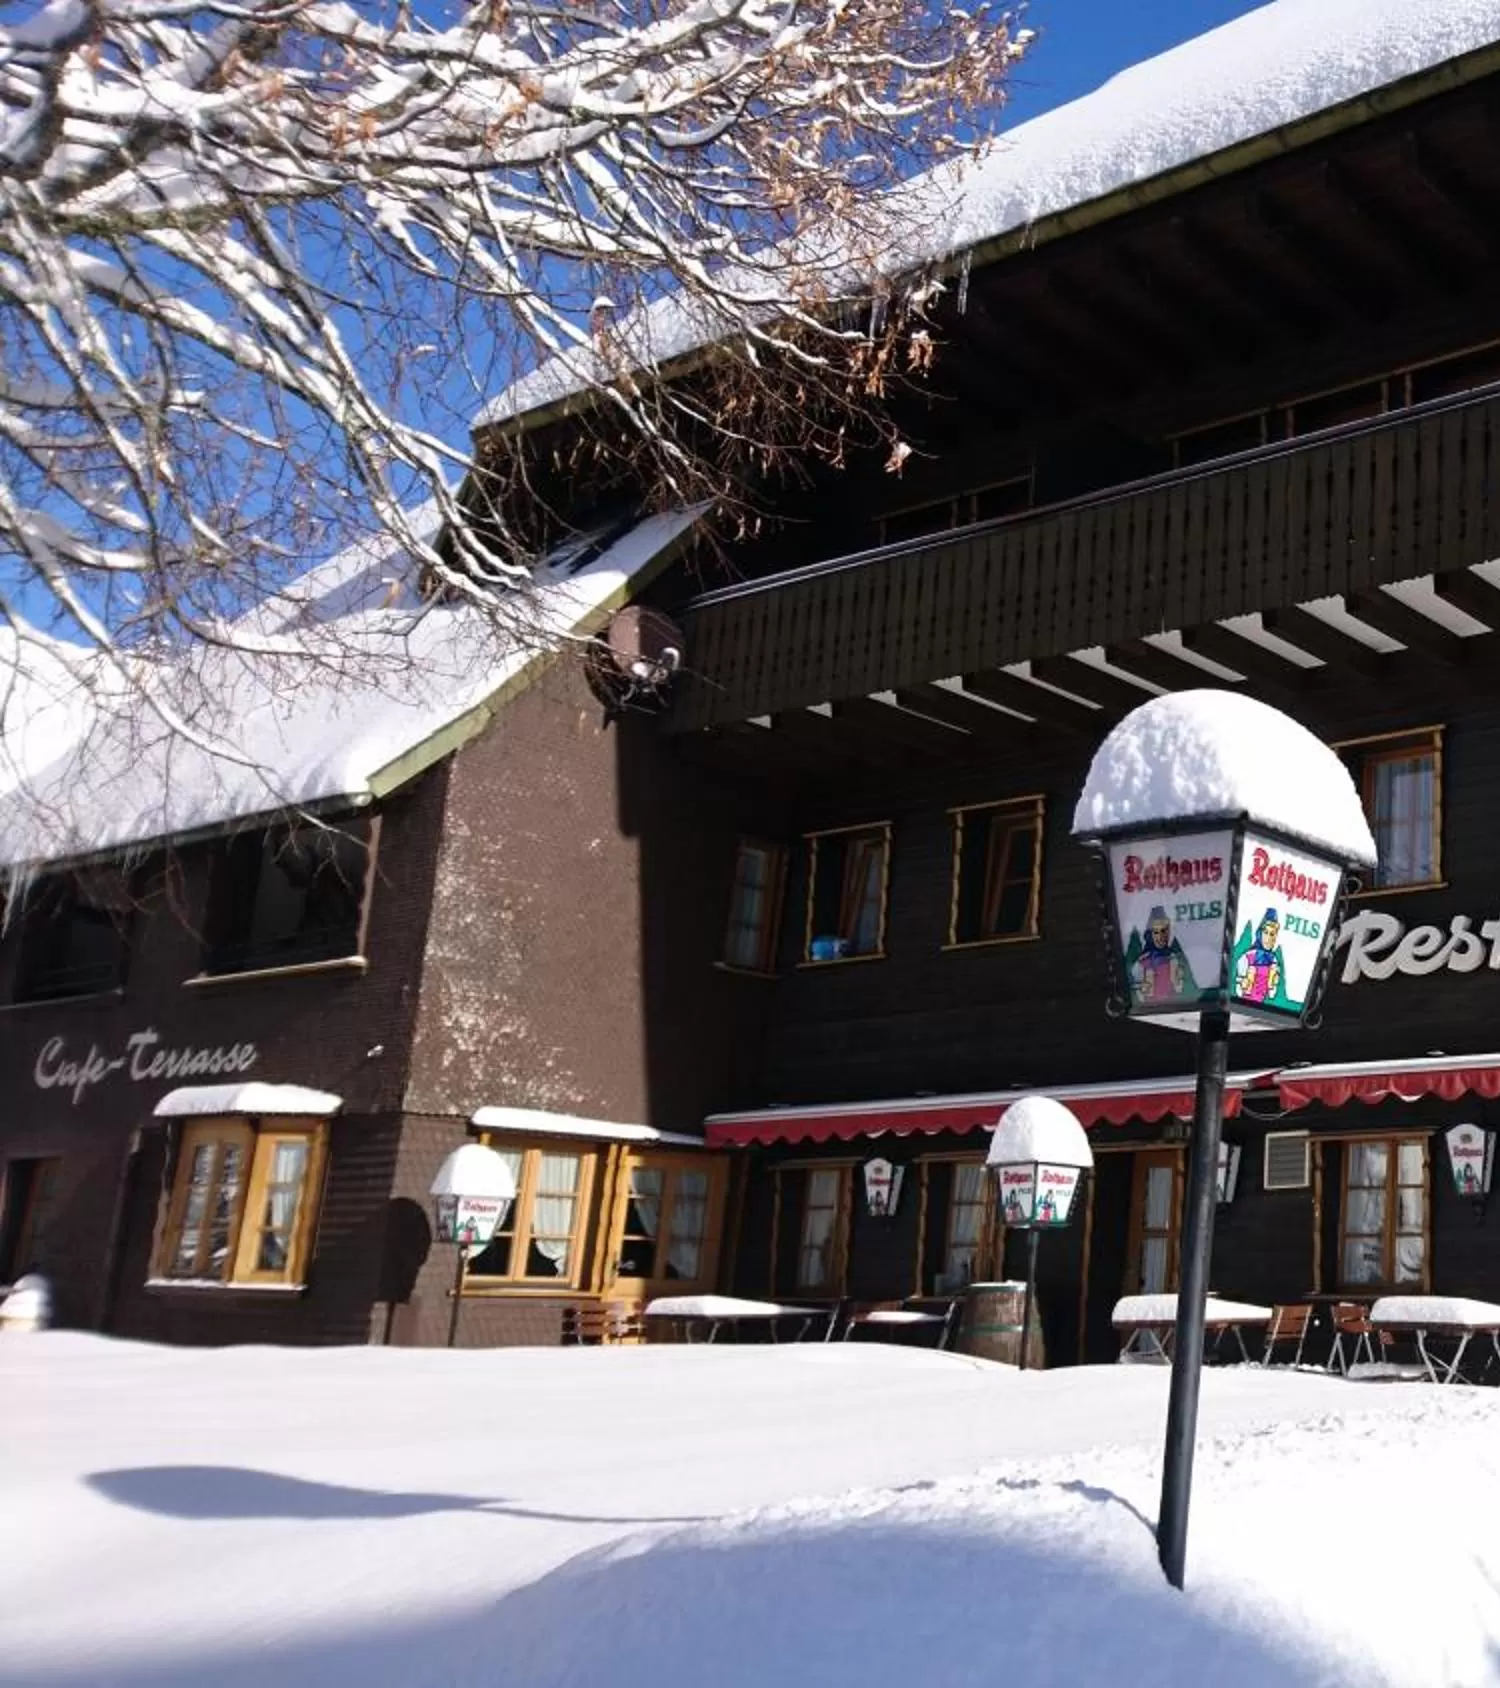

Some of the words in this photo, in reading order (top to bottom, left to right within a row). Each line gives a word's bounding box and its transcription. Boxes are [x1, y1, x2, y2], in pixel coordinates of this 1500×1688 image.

[1122, 855, 1223, 894] Rothaus
[1248, 846, 1328, 905] Rothaus
[1175, 900, 1222, 922] PILS
[1284, 913, 1321, 940] PILS
